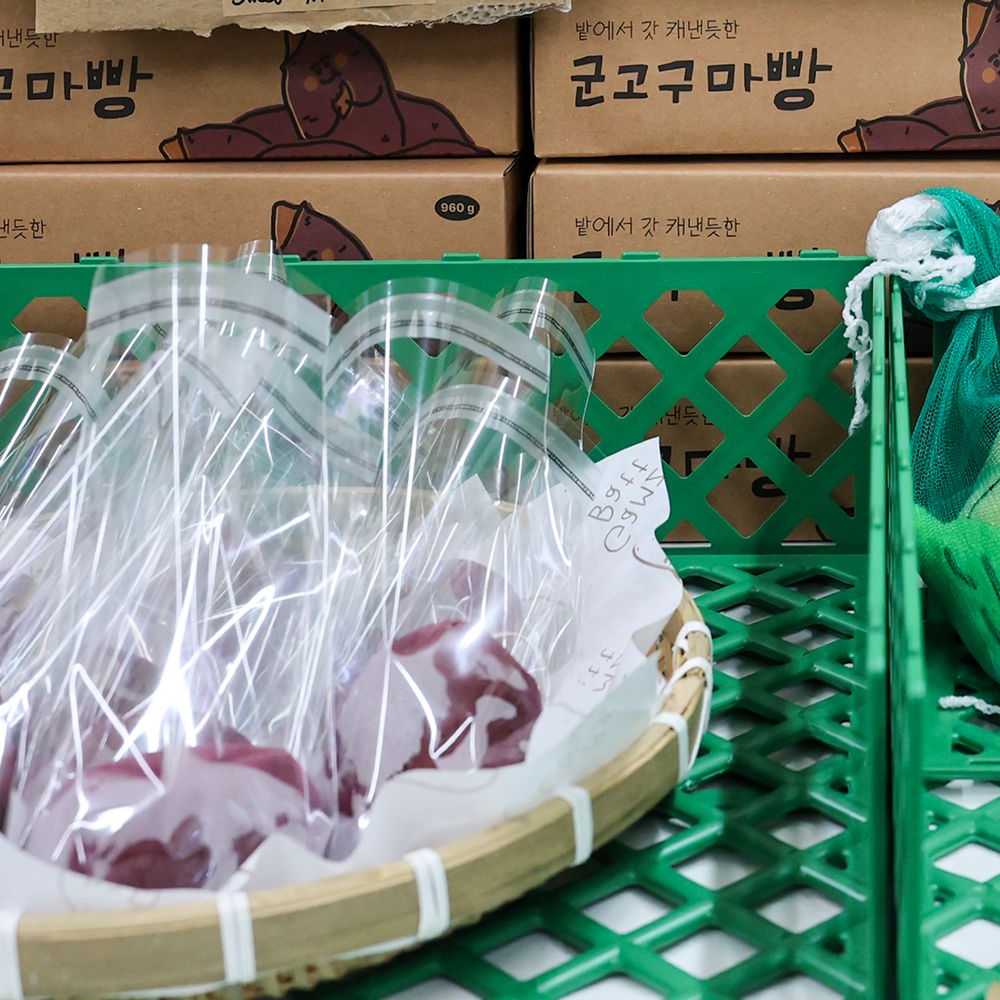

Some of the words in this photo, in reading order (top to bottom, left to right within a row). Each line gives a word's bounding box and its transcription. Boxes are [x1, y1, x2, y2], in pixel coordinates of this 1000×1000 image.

[574, 19, 635, 41] 밭에서
[640, 20, 658, 41] 갓
[665, 19, 740, 40] 캐낸듯한
[570, 47, 833, 112] 군고구마빵
[440, 202, 464, 213] 960
[467, 203, 475, 216] g
[574, 216, 635, 238] 밭에서
[640, 217, 659, 238] 갓
[665, 216, 740, 238] 캐낸듯한
